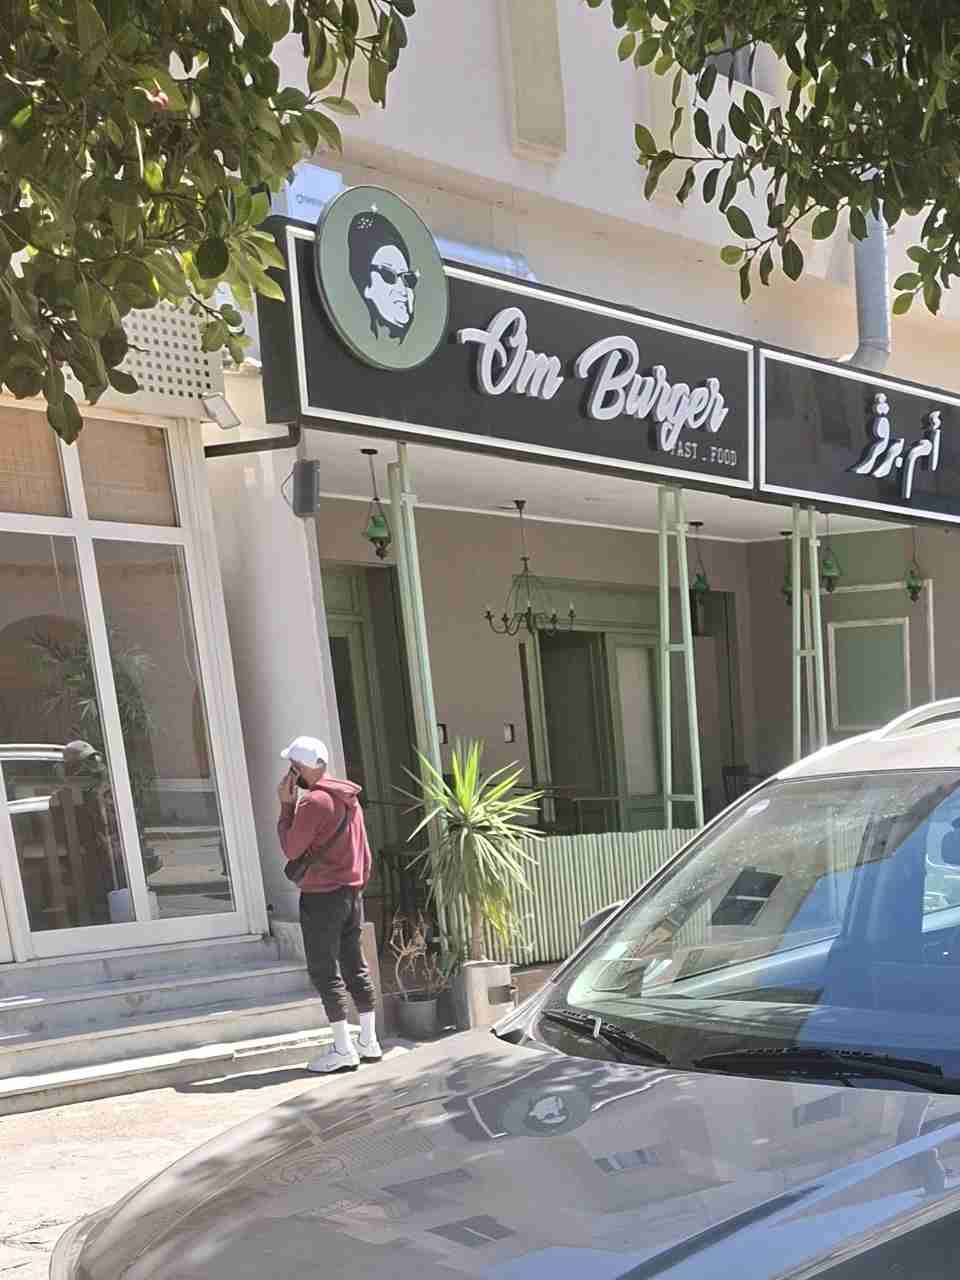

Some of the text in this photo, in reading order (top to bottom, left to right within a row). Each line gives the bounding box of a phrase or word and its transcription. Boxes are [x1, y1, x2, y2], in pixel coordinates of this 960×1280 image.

[457, 307, 729, 451] Om Burger
[710, 446, 737, 466] FOOD
